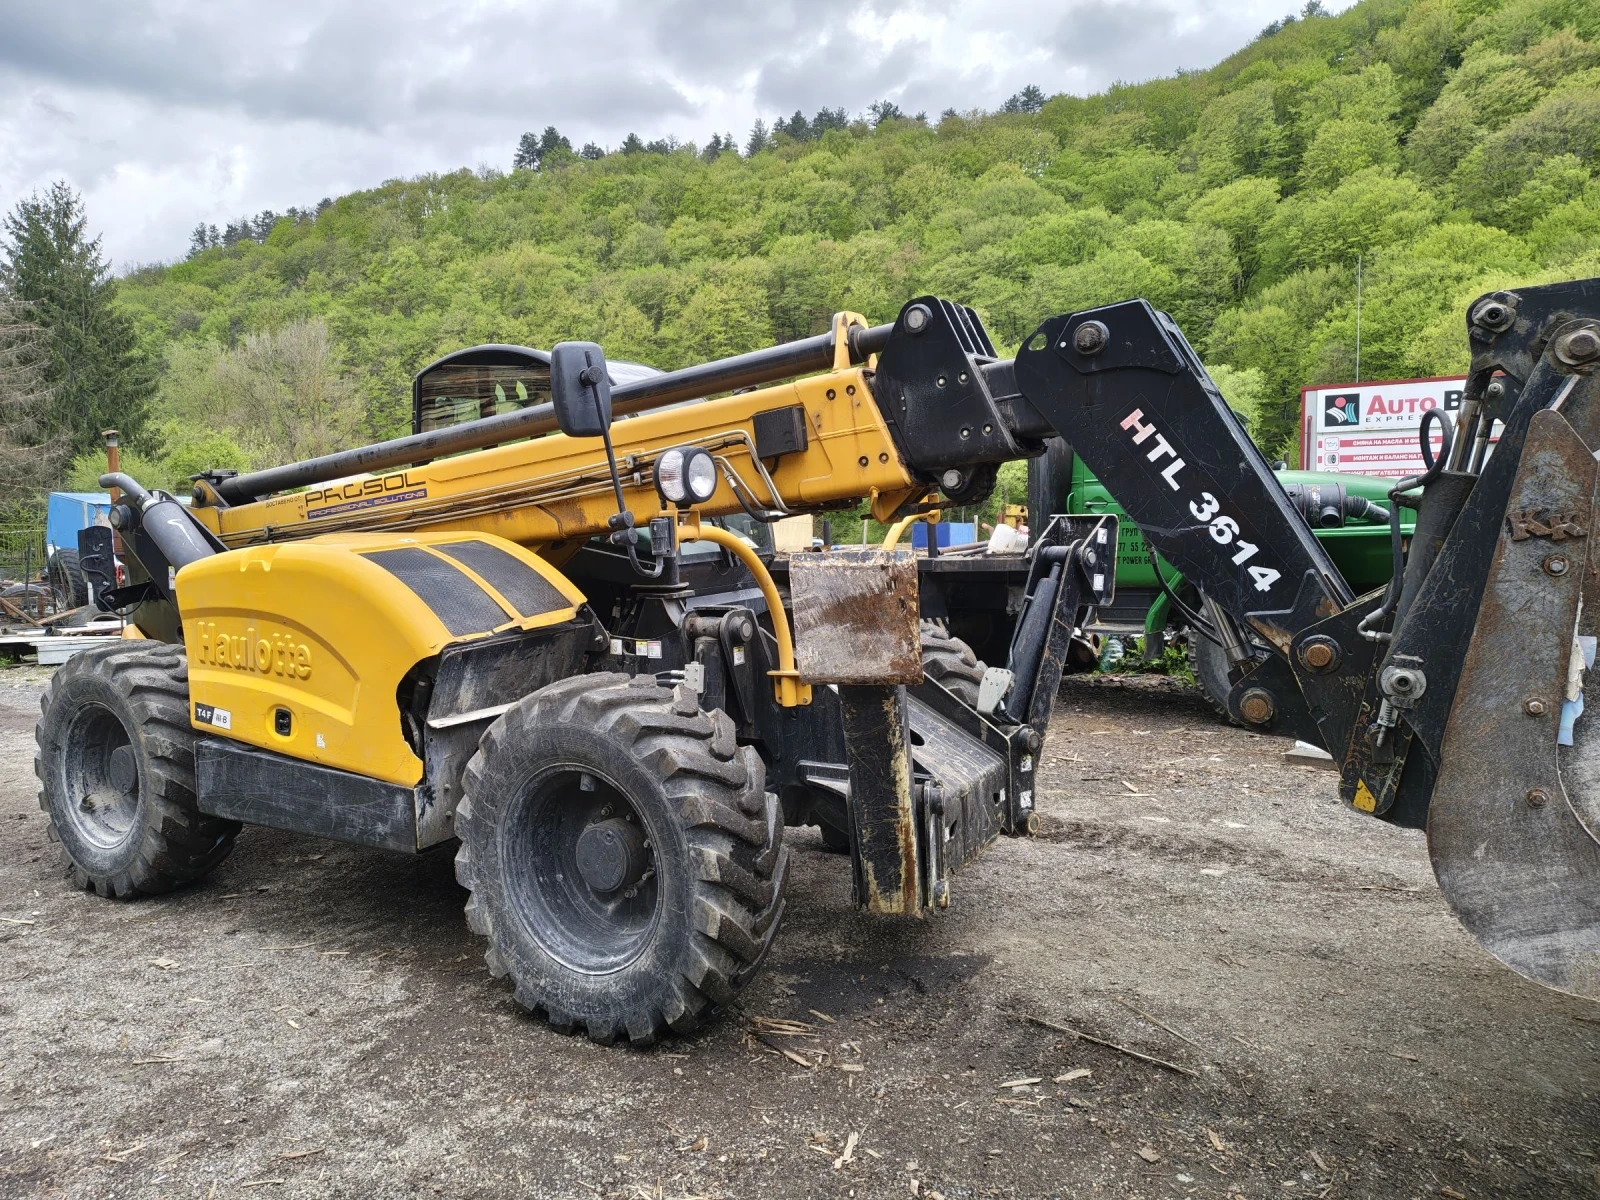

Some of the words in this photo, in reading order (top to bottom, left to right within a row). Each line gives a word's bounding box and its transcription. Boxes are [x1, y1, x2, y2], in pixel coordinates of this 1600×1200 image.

[374, 490, 425, 505] SOLUTIONS
[1119, 408, 1186, 491] HTL
[1189, 492, 1282, 592] 3614
[196, 621, 312, 680] Haulotte
